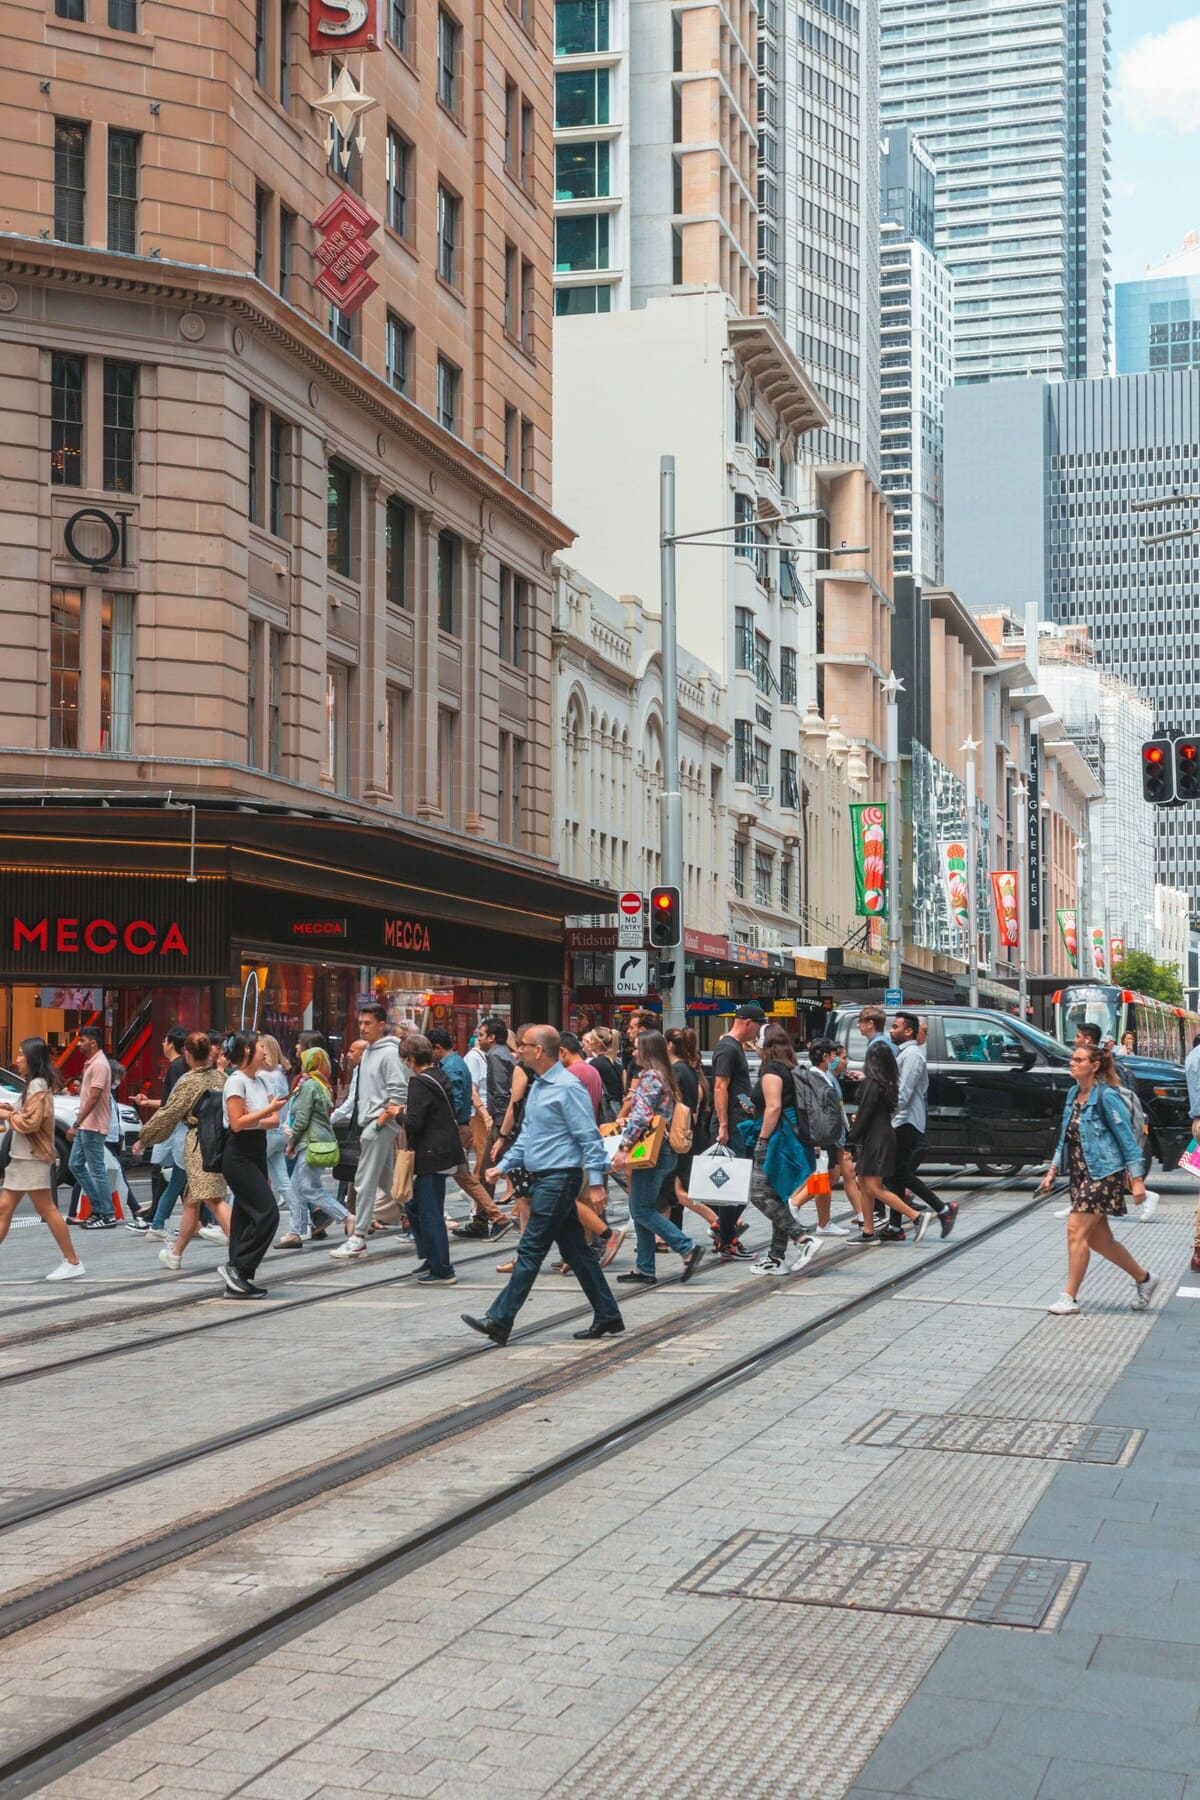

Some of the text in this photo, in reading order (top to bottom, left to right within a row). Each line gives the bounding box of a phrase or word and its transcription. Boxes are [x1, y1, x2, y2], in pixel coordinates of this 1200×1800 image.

[316, 221, 360, 266] BAR &
[330, 239, 372, 281] GRILL
[64, 508, 133, 574] QT
[1028, 746, 1038, 906] THE GALERIES
[13, 916, 188, 956] MECCA
[292, 922, 342, 934] MECCA
[384, 917, 431, 952] MECCA
[624, 916, 638, 924] NO
[571, 932, 618, 946] Kidstuf
[617, 982, 644, 991] ONLY
